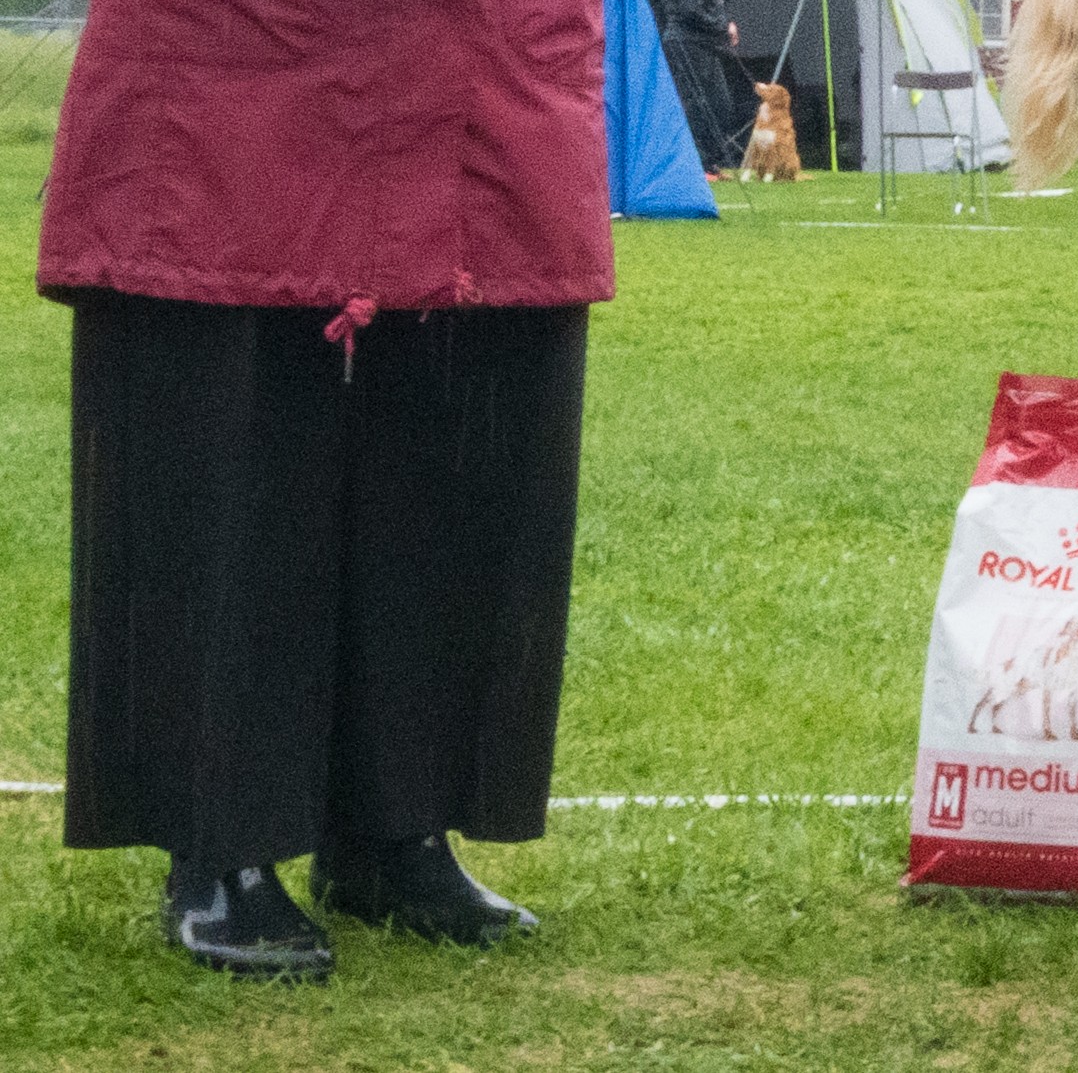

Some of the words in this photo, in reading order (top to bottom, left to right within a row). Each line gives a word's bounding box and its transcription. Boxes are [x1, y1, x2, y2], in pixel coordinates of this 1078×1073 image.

[978, 550, 1075, 592] ROYAL
[935, 775, 962, 818] M
[972, 808, 1035, 828] adult
